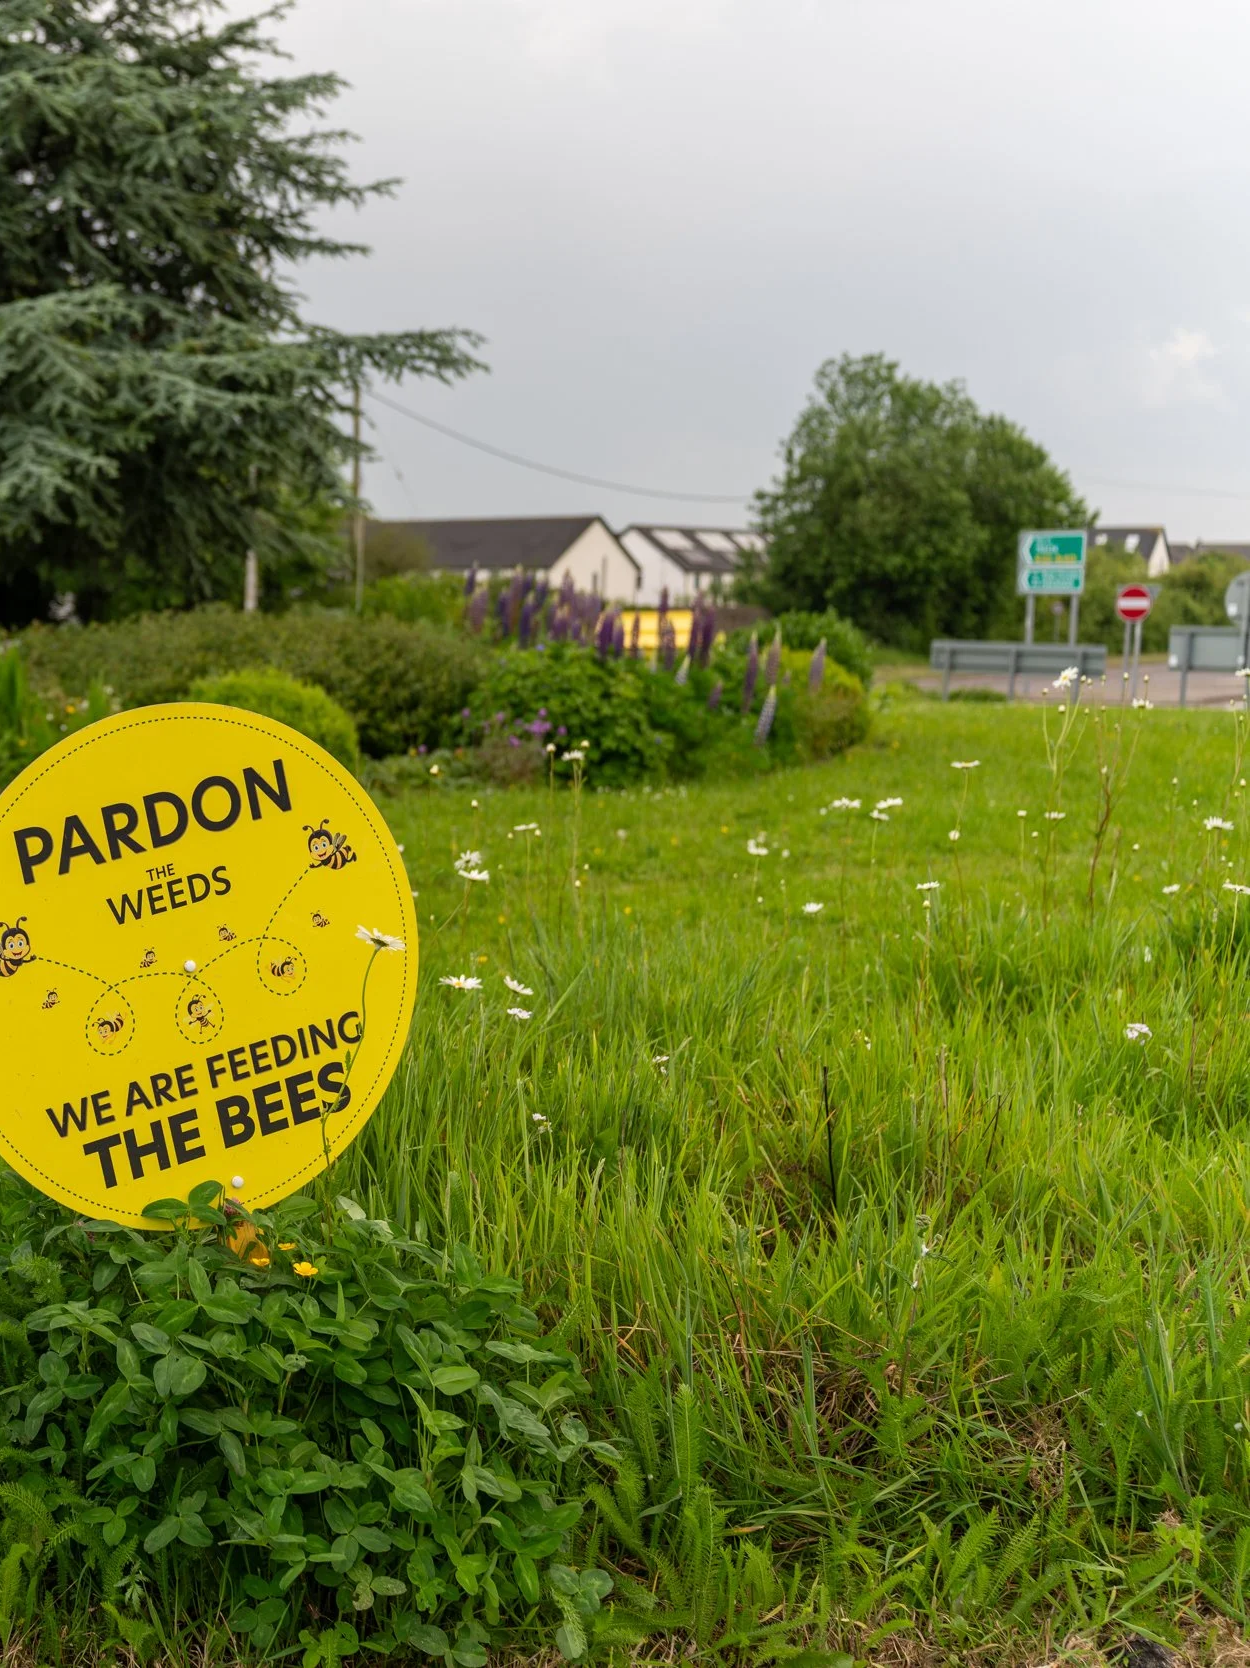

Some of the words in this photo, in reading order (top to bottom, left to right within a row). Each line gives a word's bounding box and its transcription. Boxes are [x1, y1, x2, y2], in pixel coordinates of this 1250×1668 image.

[13, 759, 291, 884] PARDON
[146, 862, 175, 882] THE
[106, 866, 231, 924] WEEDS
[46, 1090, 115, 1138] WE
[126, 1064, 198, 1117] ARE
[206, 1010, 365, 1089] FEEDING
[83, 1109, 206, 1189] THE
[216, 1060, 351, 1149] BEES
